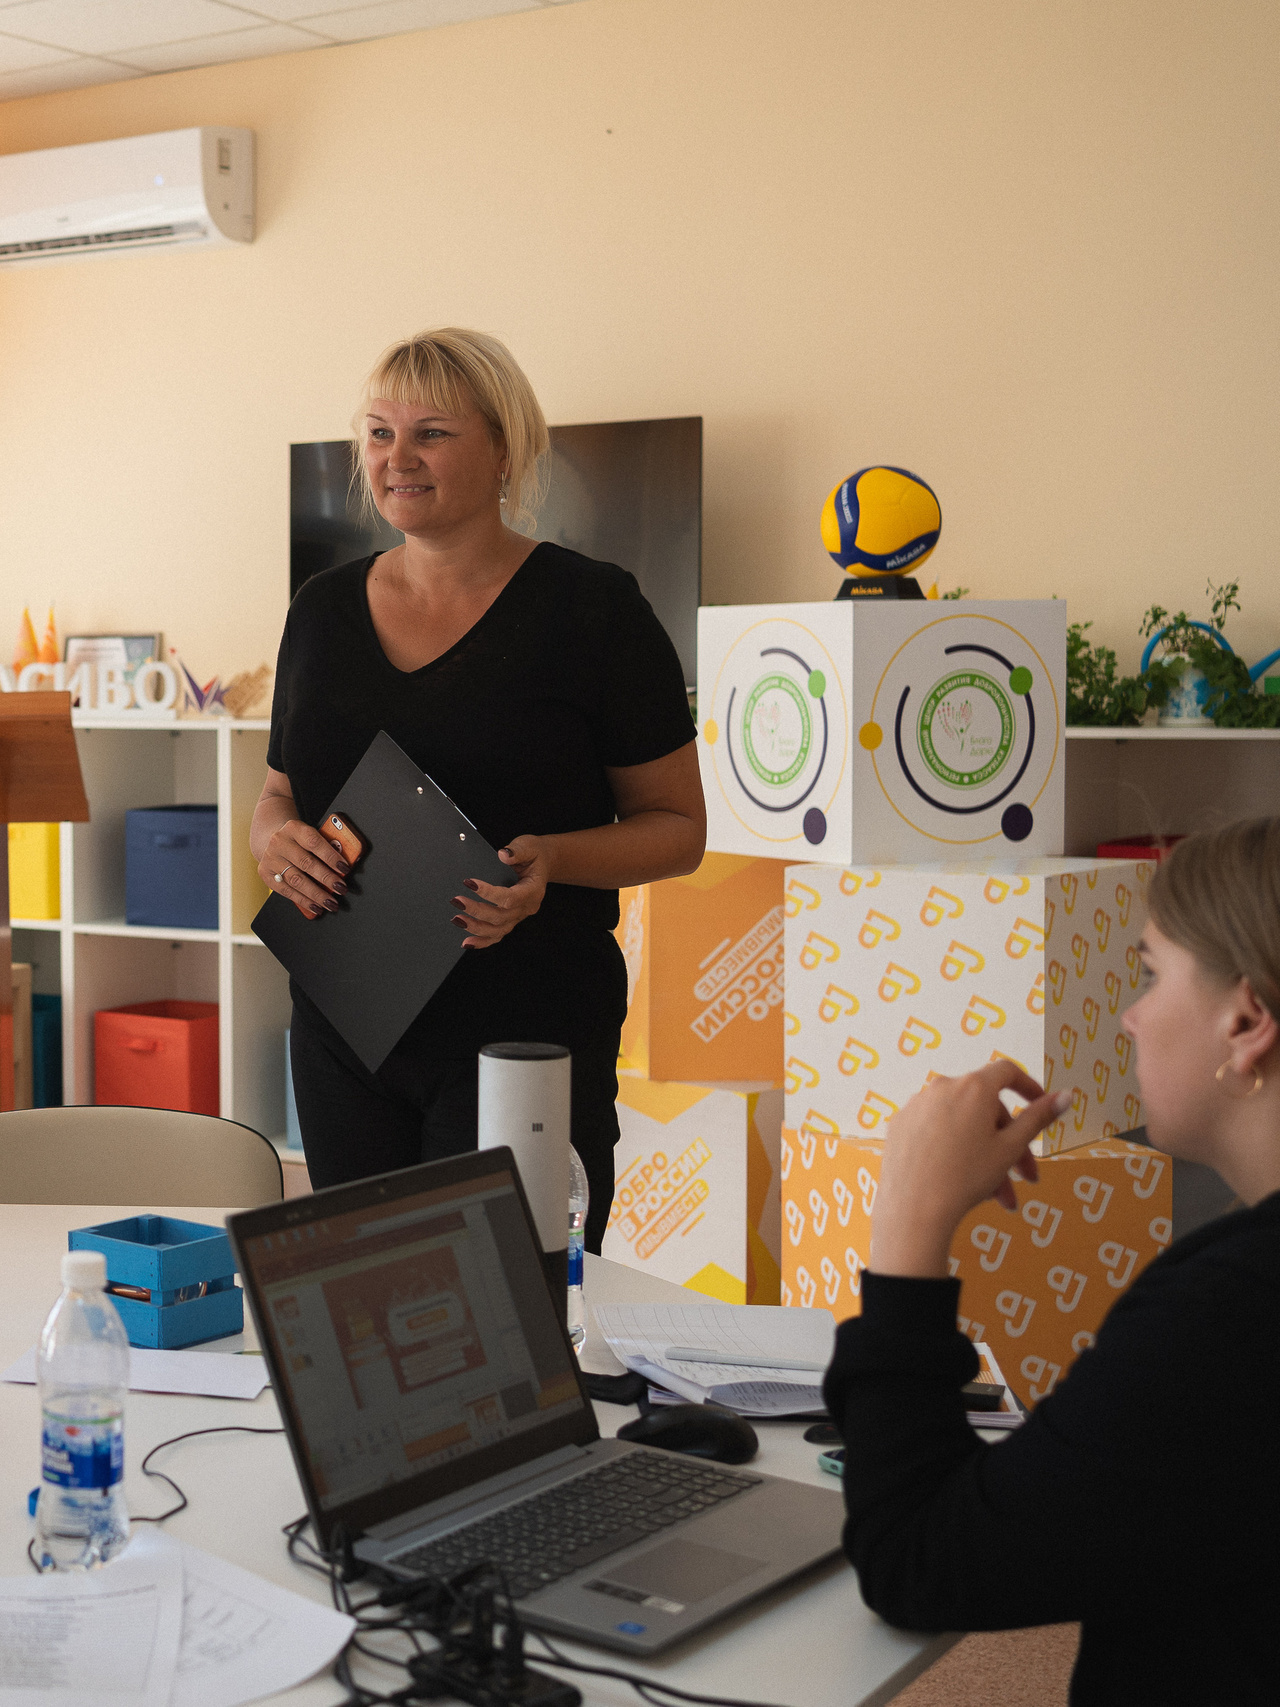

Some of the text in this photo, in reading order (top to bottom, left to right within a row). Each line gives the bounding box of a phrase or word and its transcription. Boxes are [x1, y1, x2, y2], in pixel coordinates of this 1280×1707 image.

[886, 542, 926, 570] MIKASA
[850, 584, 884, 597] MIKASA
[934, 675, 971, 698] РАЗВИТИЯ
[633, 1140, 708, 1224] РОССИИ
